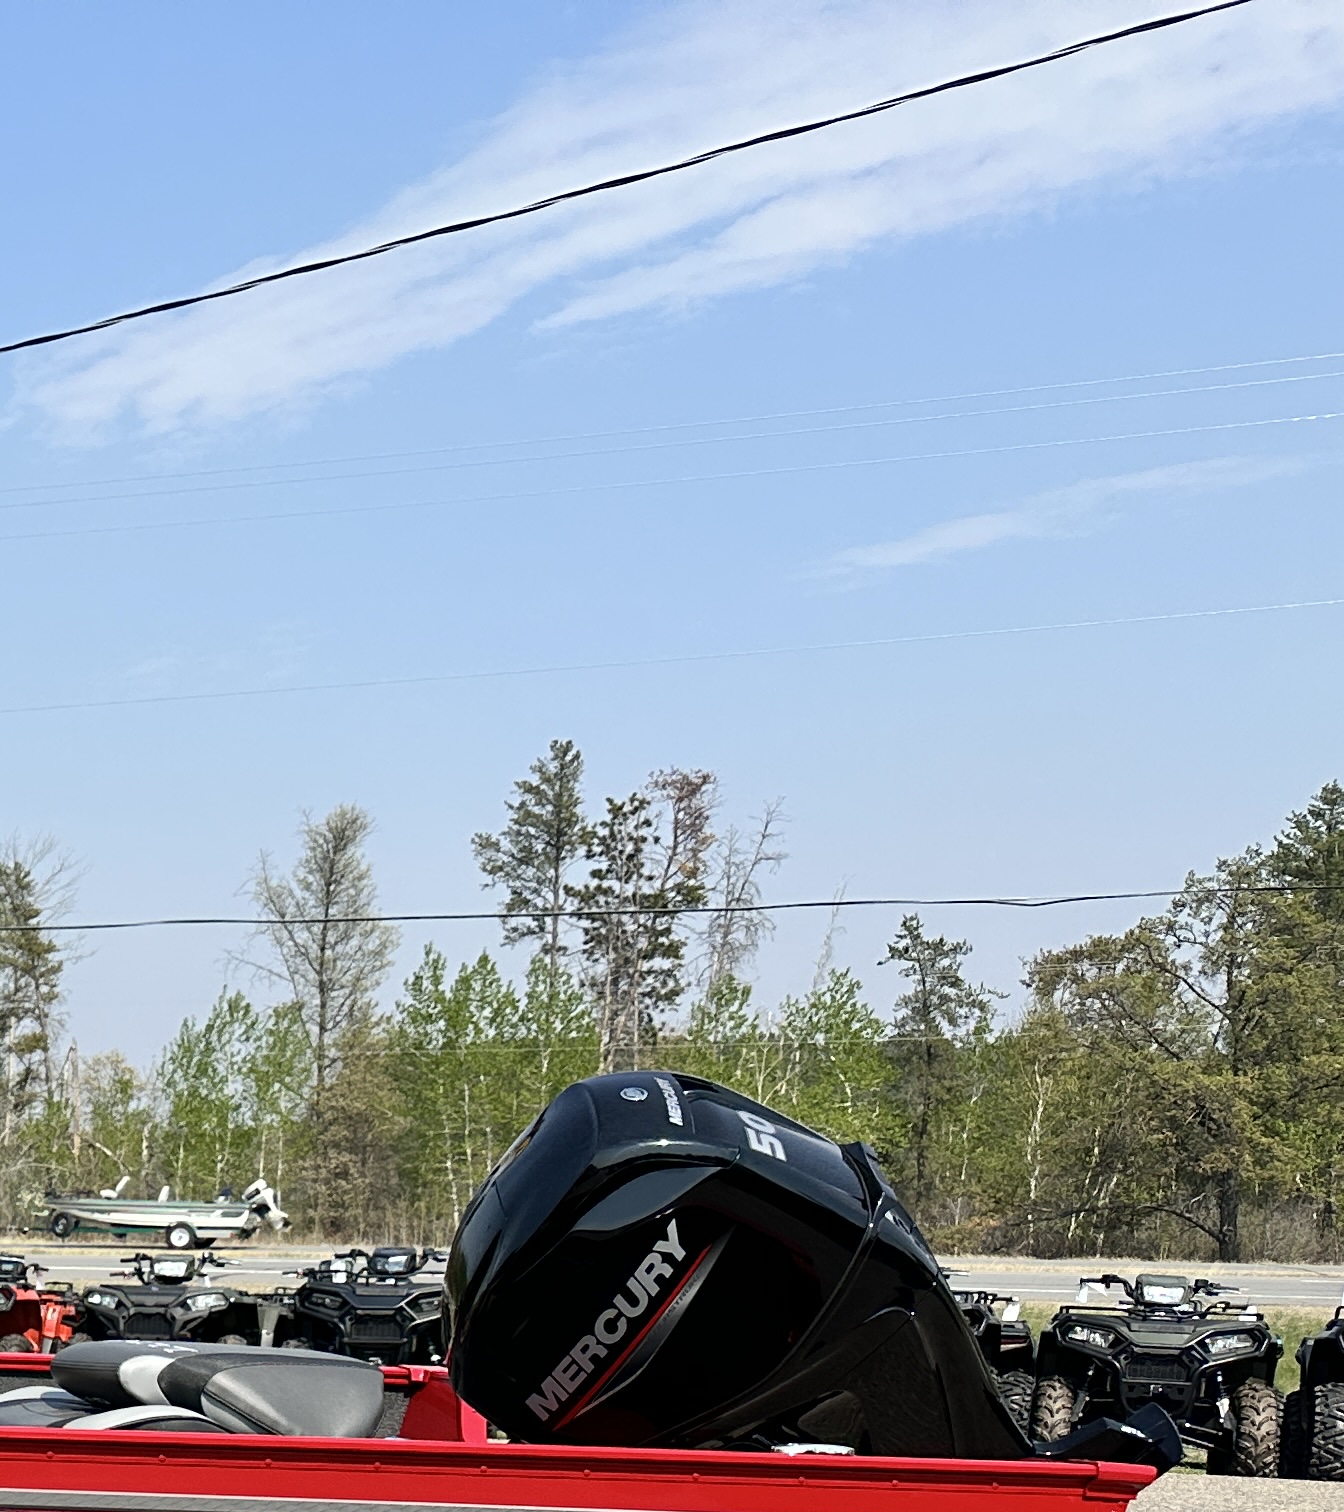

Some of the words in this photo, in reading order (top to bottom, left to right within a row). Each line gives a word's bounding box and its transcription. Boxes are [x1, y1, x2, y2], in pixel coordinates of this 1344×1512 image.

[653, 1076, 684, 1127] MERCURY
[735, 1109, 787, 1163] 50
[524, 1217, 687, 1422] MERCURY
